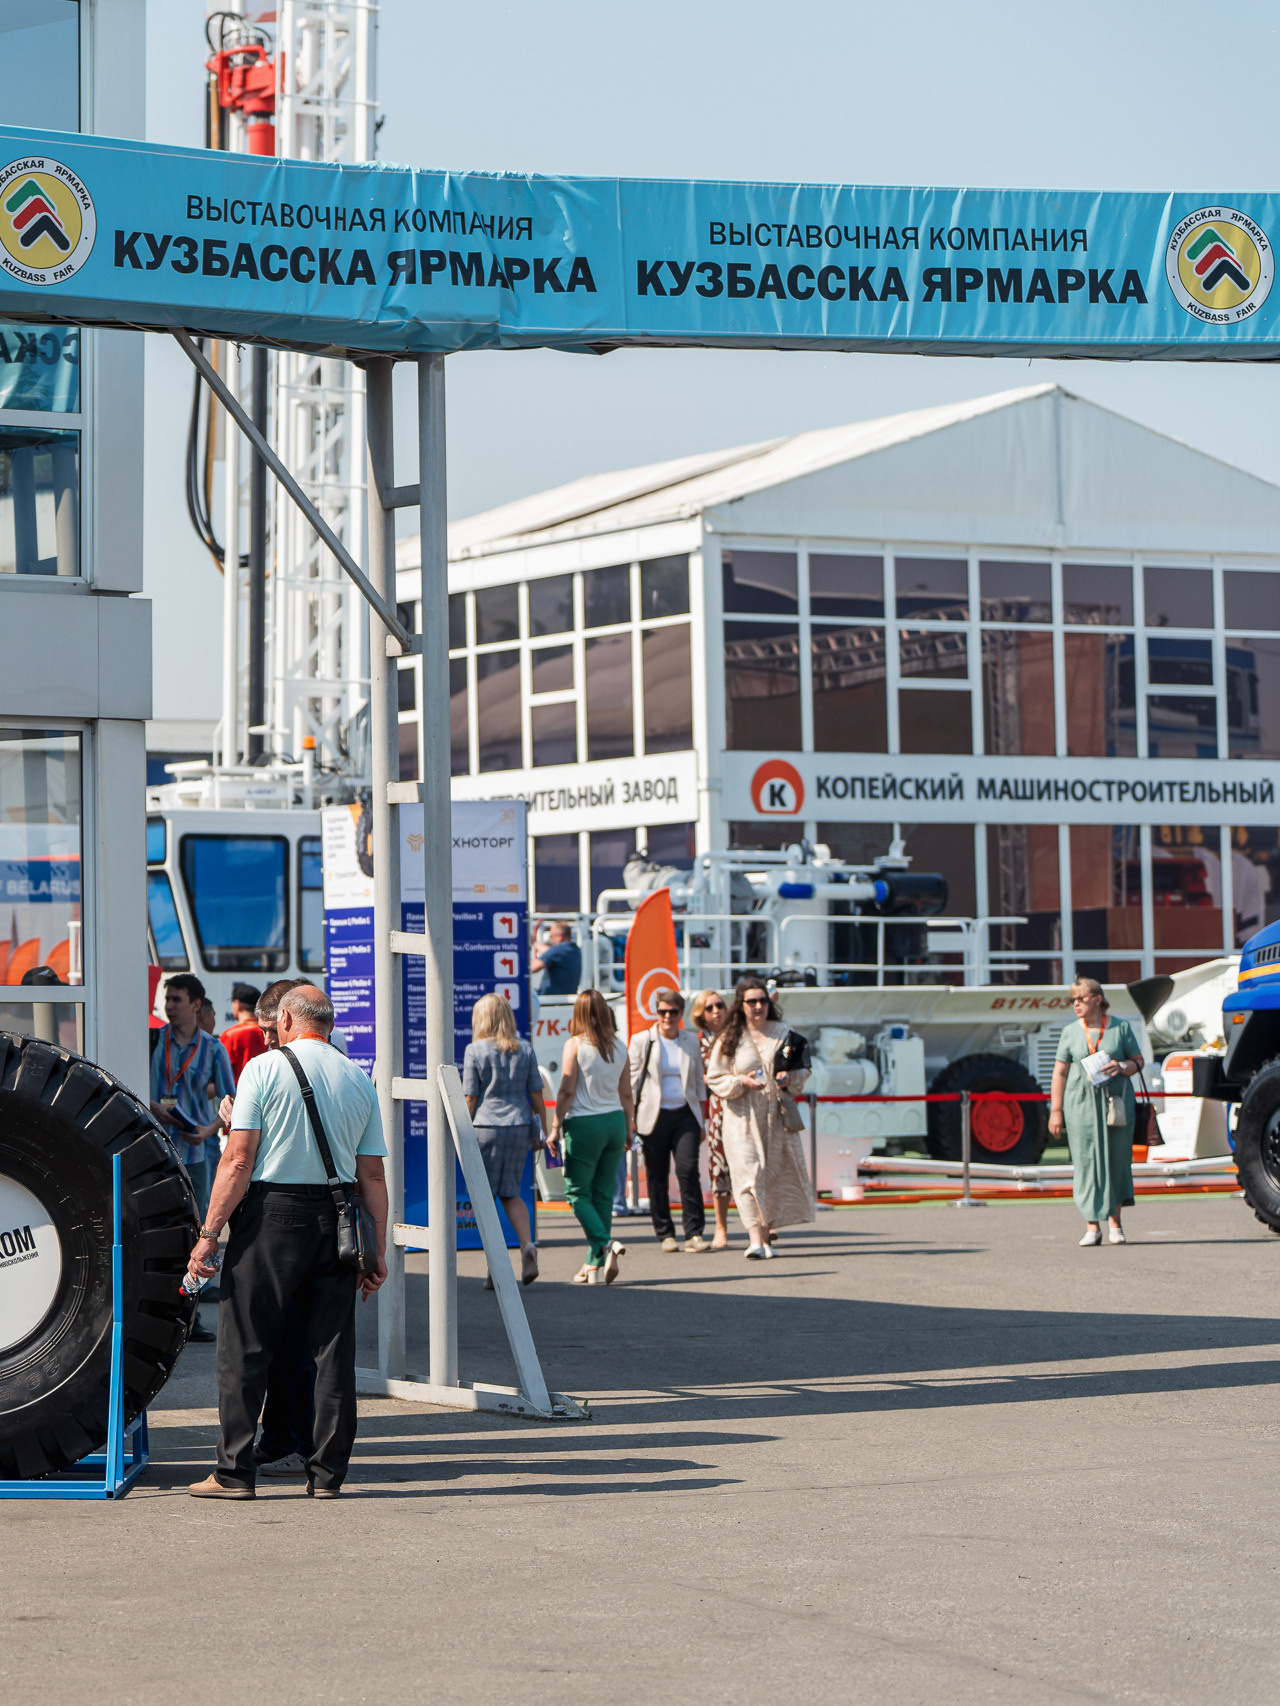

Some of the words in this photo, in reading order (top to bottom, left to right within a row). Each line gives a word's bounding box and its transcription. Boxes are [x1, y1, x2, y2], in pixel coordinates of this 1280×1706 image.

[54, 165, 91, 211] ЯРМАРКА
[186, 194, 386, 233] ВЫСТАВОЧНАЯ
[394, 207, 533, 241] КОМПАНИЯ
[1170, 209, 1221, 251] КУЗБАССКАЯ
[1230, 212, 1268, 251] ЯРМАРКА
[708, 221, 920, 250] ВЫСТАВОЧНАЯ
[928, 226, 1089, 253] КОМПАНИЯ
[2, 258, 46, 282] KUZBASS
[53, 264, 75, 280] FAIR
[114, 229, 377, 287] КУЗБАССКА
[387, 248, 598, 295] ЯРМАРКА
[636, 259, 910, 303] КУЗБАССКА
[921, 266, 1149, 305] ЯРМАРКА
[1187, 301, 1230, 321] KUZBASS
[1236, 302, 1256, 318] FAIR
[622, 777, 678, 804] ЗАВОД
[769, 783, 786, 807] К
[815, 773, 964, 800] КОПЕЙСКИЙ
[977, 778, 1274, 804] МАШИНОСТРОИТЕЛЬНЫЙ
[452, 837, 515, 849] ХНОТОРГ
[6, 879, 81, 896] BELARUS
